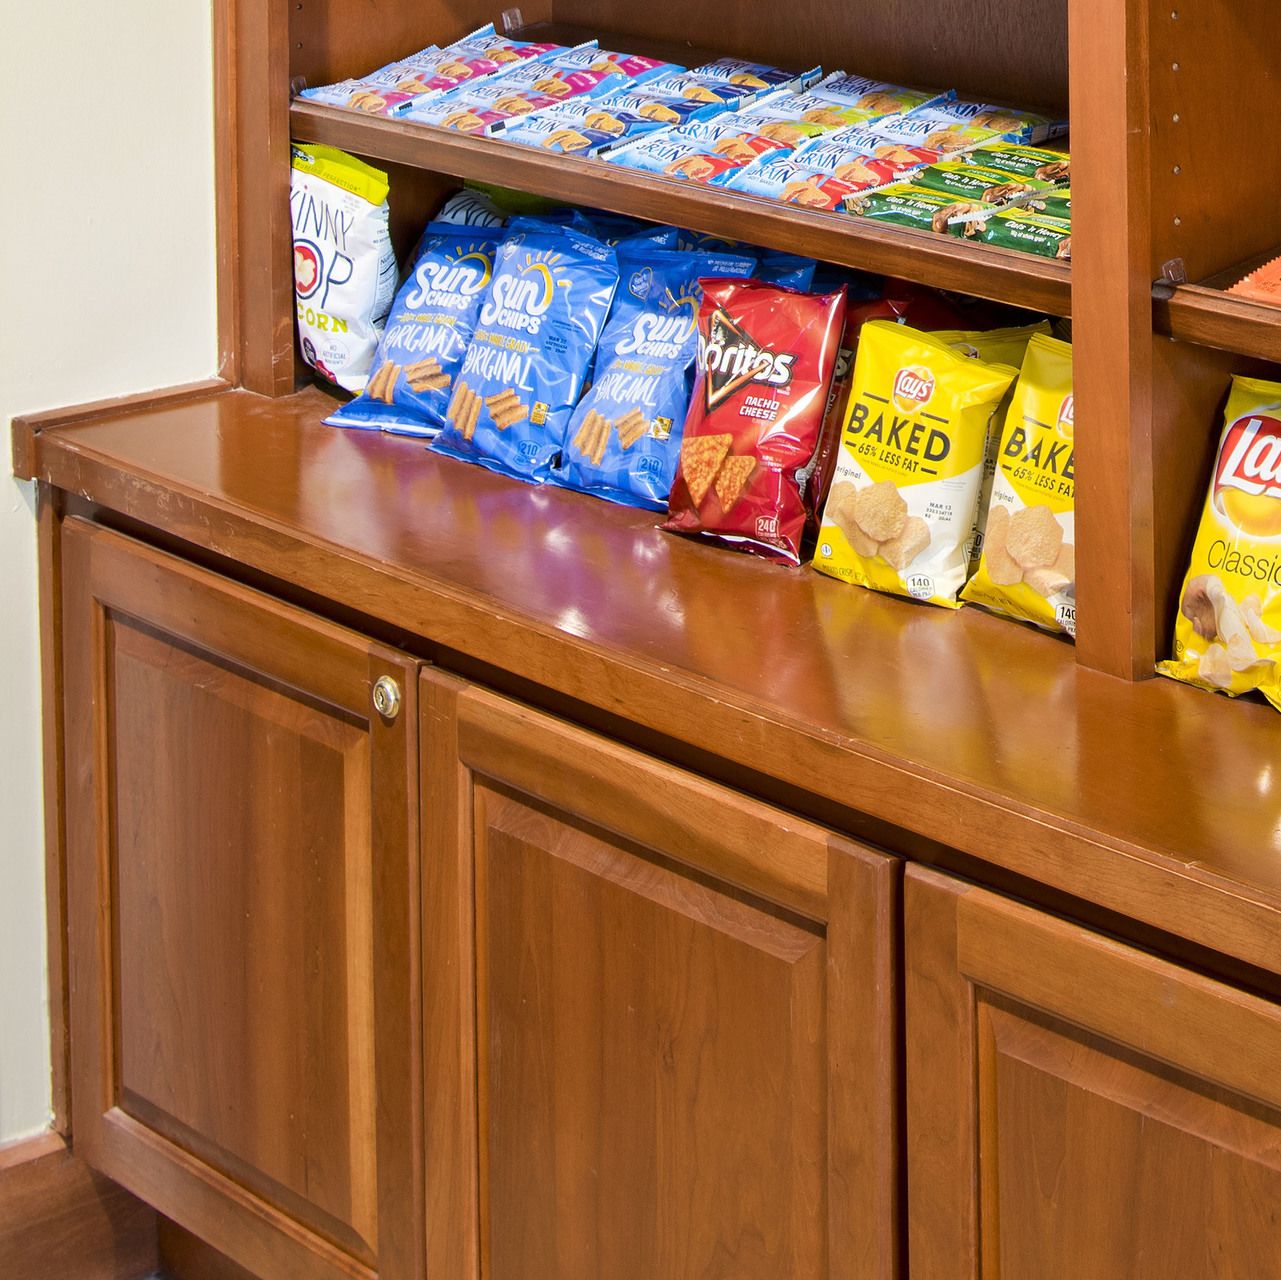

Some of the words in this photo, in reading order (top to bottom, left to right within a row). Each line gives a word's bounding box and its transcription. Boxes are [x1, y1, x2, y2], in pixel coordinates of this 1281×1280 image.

[832, 134, 880, 149] GRAIN
[886, 196, 905, 204] Oats
[915, 200, 940, 211] Honey
[406, 261, 478, 310] Sun
[425, 291, 471, 311] CHIPS
[480, 272, 545, 325] Sun
[497, 308, 541, 334] CHIPS
[463, 343, 534, 392] ORIGINAL
[697, 335, 794, 385] Doritos
[596, 375, 656, 406] ORIGINAL
[745, 396, 780, 410] NACHO
[740, 406, 778, 421] CHEESE
[846, 403, 951, 462] BAKED
[858, 444, 877, 457] 65%
[879, 449, 901, 467] LESS
[901, 456, 919, 473] FAT
[837, 465, 861, 479] original
[1013, 467, 1033, 481] 65%
[1035, 475, 1056, 492] LESS
[910, 577, 930, 588] 140
